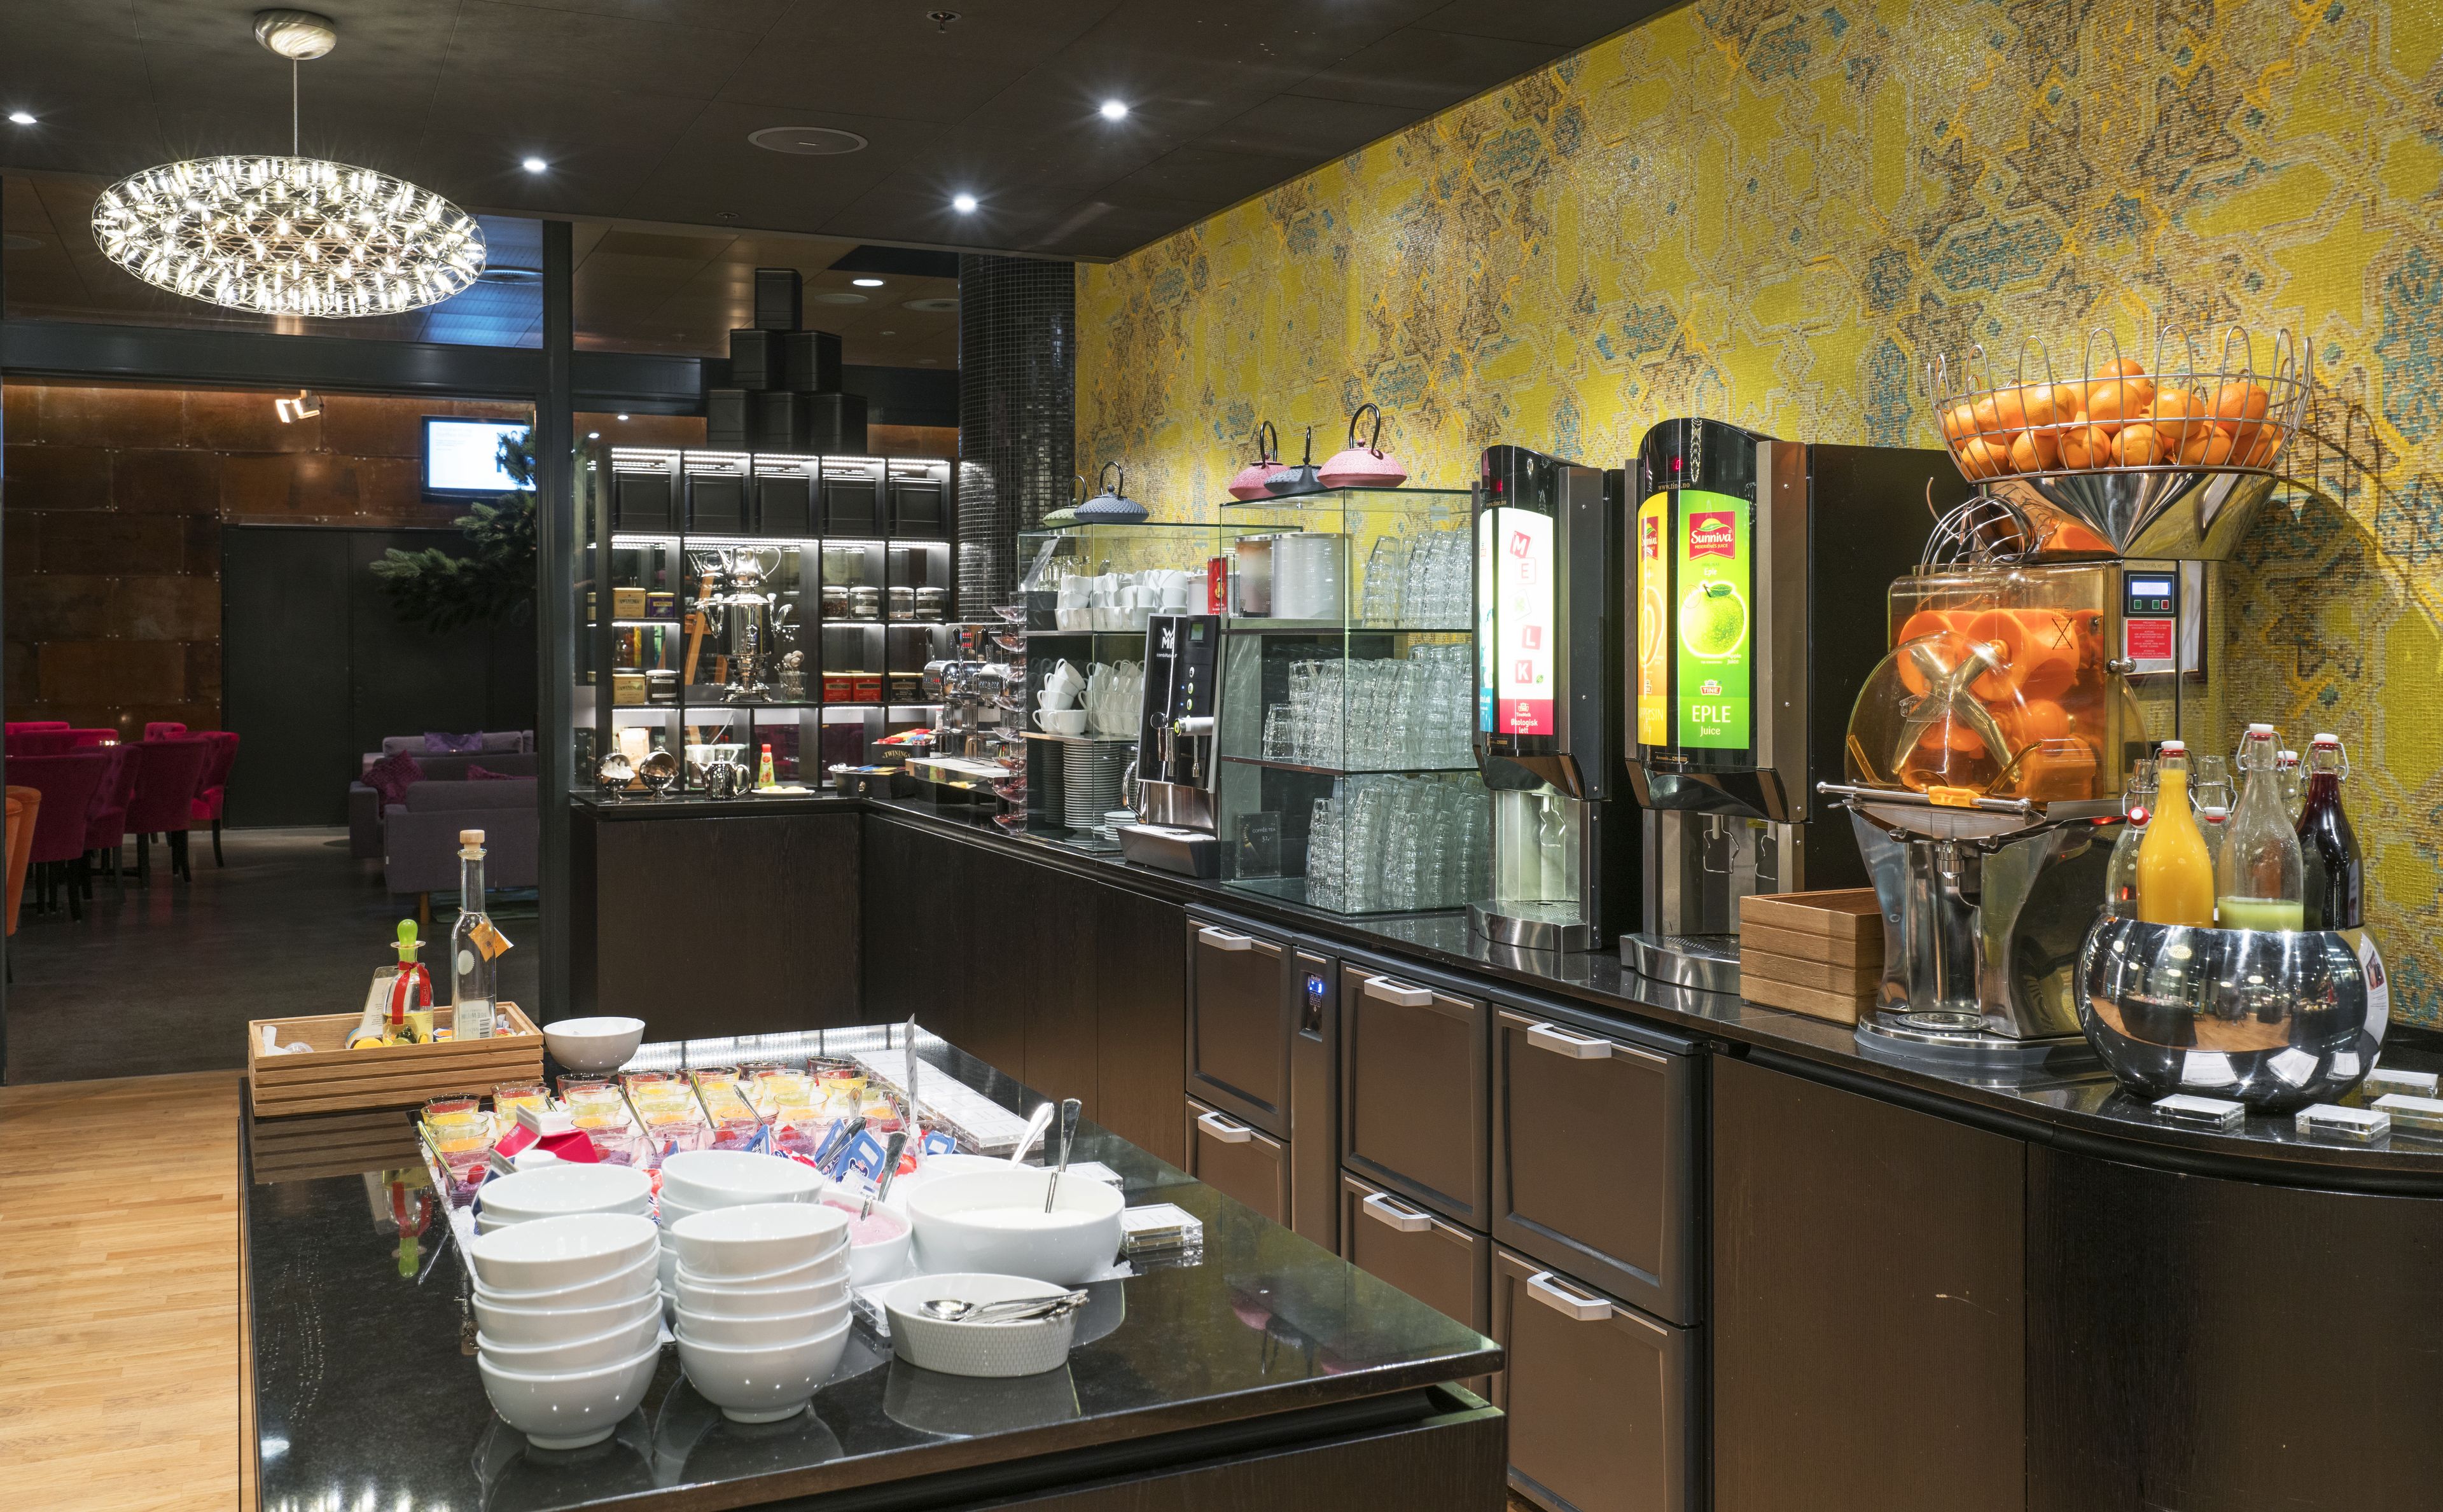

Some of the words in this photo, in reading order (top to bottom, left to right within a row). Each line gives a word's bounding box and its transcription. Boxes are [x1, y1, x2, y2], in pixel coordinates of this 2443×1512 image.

[1690, 530, 1733, 544] Sunniva
[1704, 567, 1718, 578] Eple
[1692, 705, 1731, 723] EPLE
[1510, 718, 1538, 728] Økologisk
[1699, 725, 1721, 737] Juice
[884, 750, 912, 758] TWININGS
